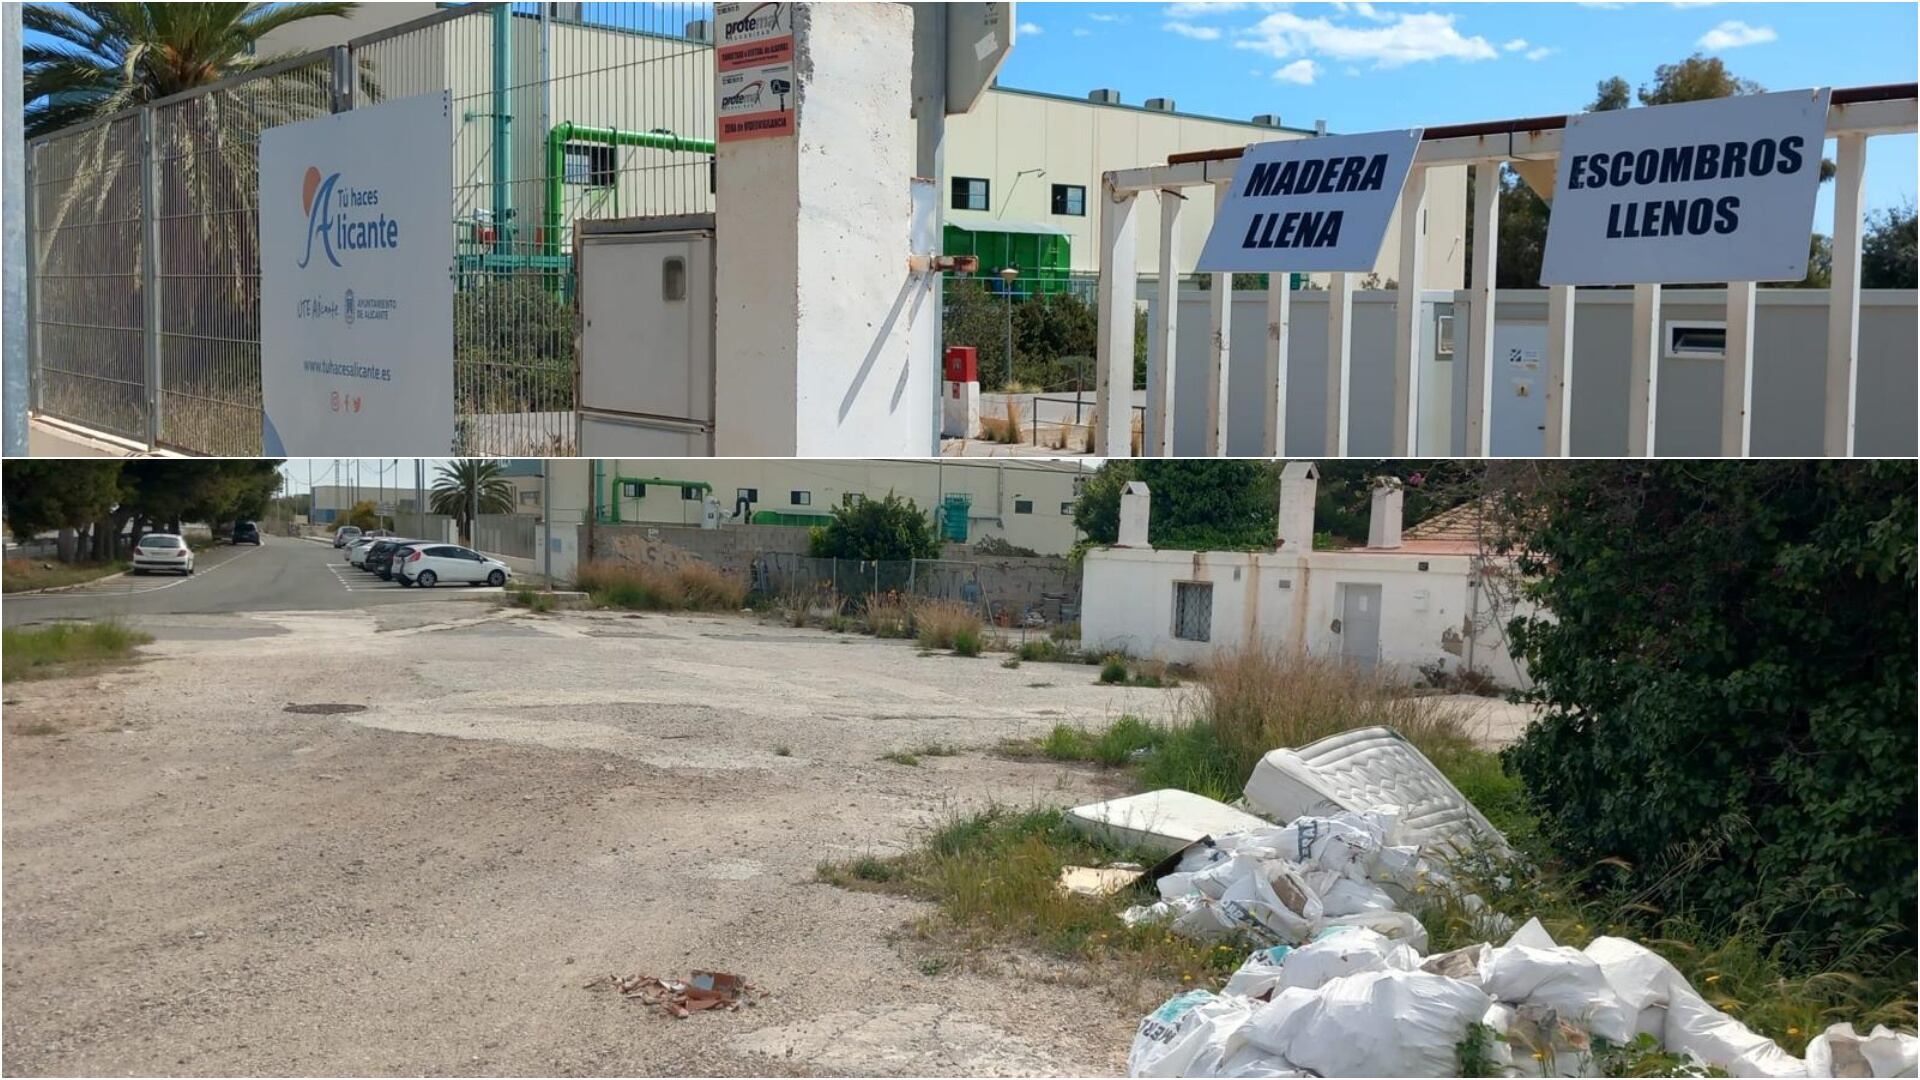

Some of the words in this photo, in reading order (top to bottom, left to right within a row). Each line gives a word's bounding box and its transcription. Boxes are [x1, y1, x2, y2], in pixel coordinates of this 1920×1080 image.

[1243, 153, 1389, 198] MADERA
[1568, 135, 1804, 190] ESCOMBROS
[351, 187, 379, 206] haces
[1242, 210, 1344, 249] LLENA
[1606, 196, 1740, 239] LLENOS
[357, 299, 397, 309] AYUNTAMIENTO
[357, 310, 364, 319] DE
[365, 310, 389, 320] ALICANTE
[303, 359, 391, 382] www.tuhacesalicante.es
